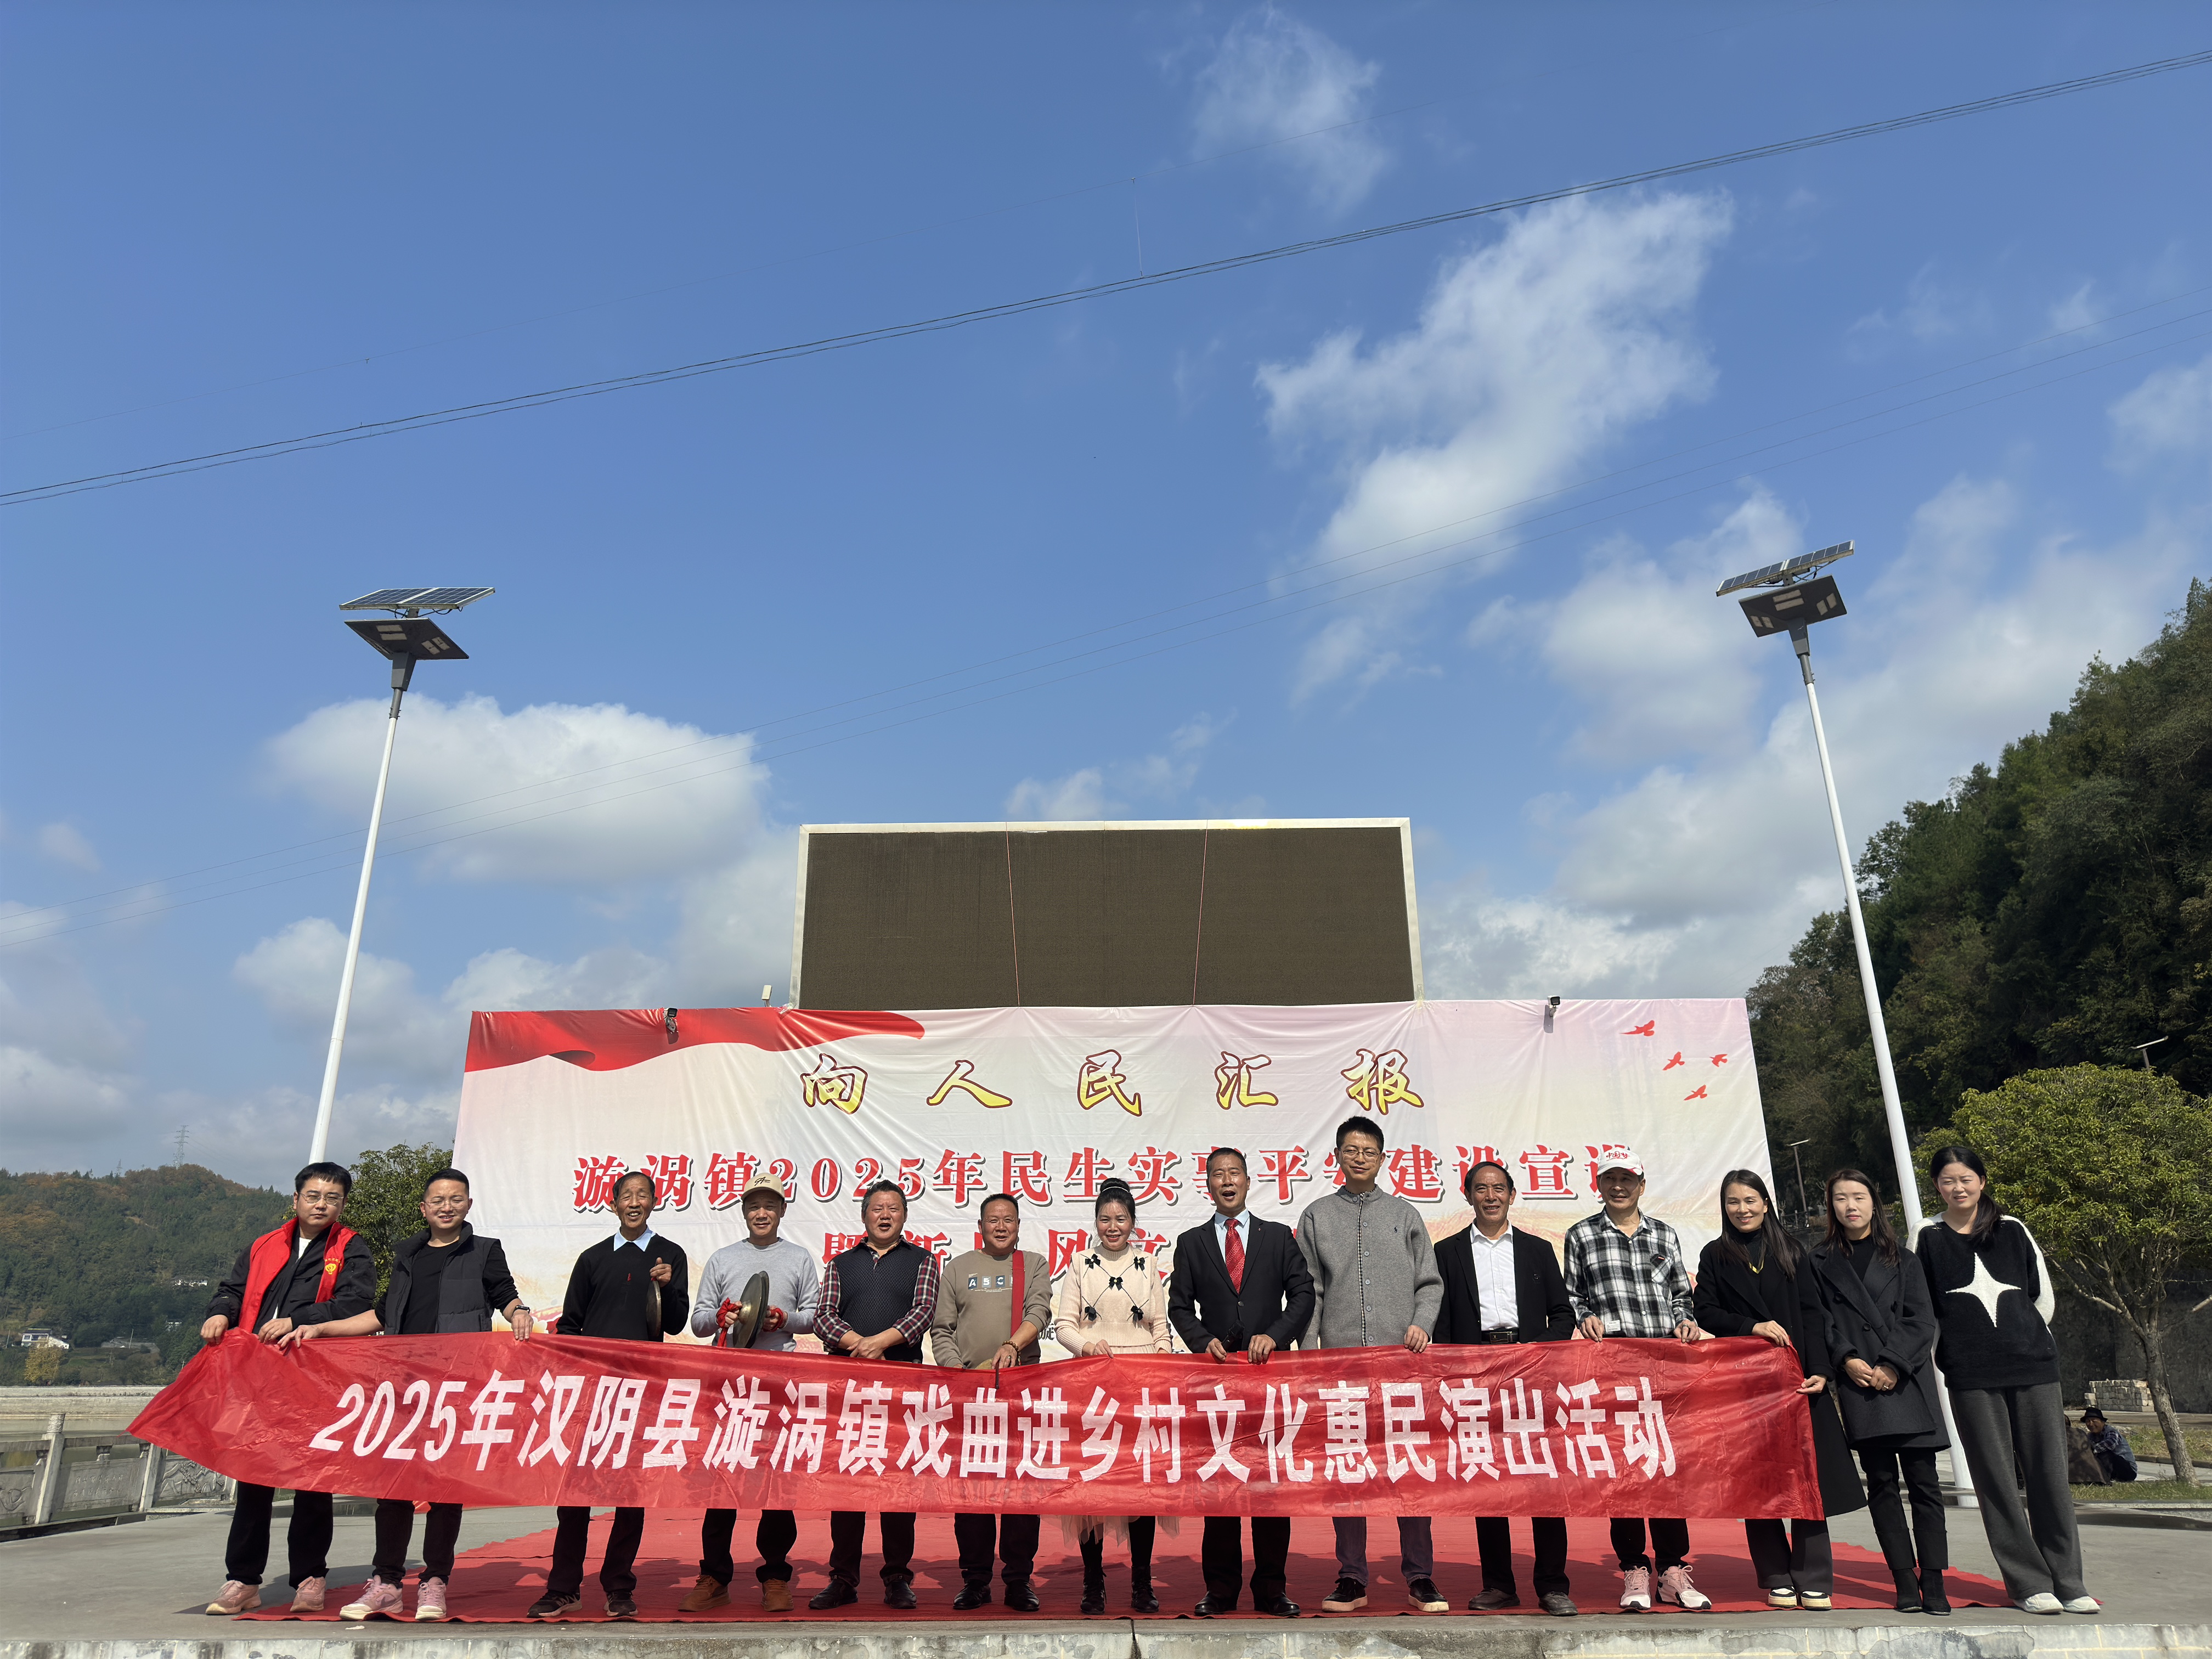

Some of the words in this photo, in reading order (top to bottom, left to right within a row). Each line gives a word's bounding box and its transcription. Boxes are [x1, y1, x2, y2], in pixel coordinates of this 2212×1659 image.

[800, 1048, 1424, 1116] 向人民汇报
[308, 1369, 1677, 1485] 2025年汉阴县漩涡镇戏曲进乡村文化惠民演出活动
